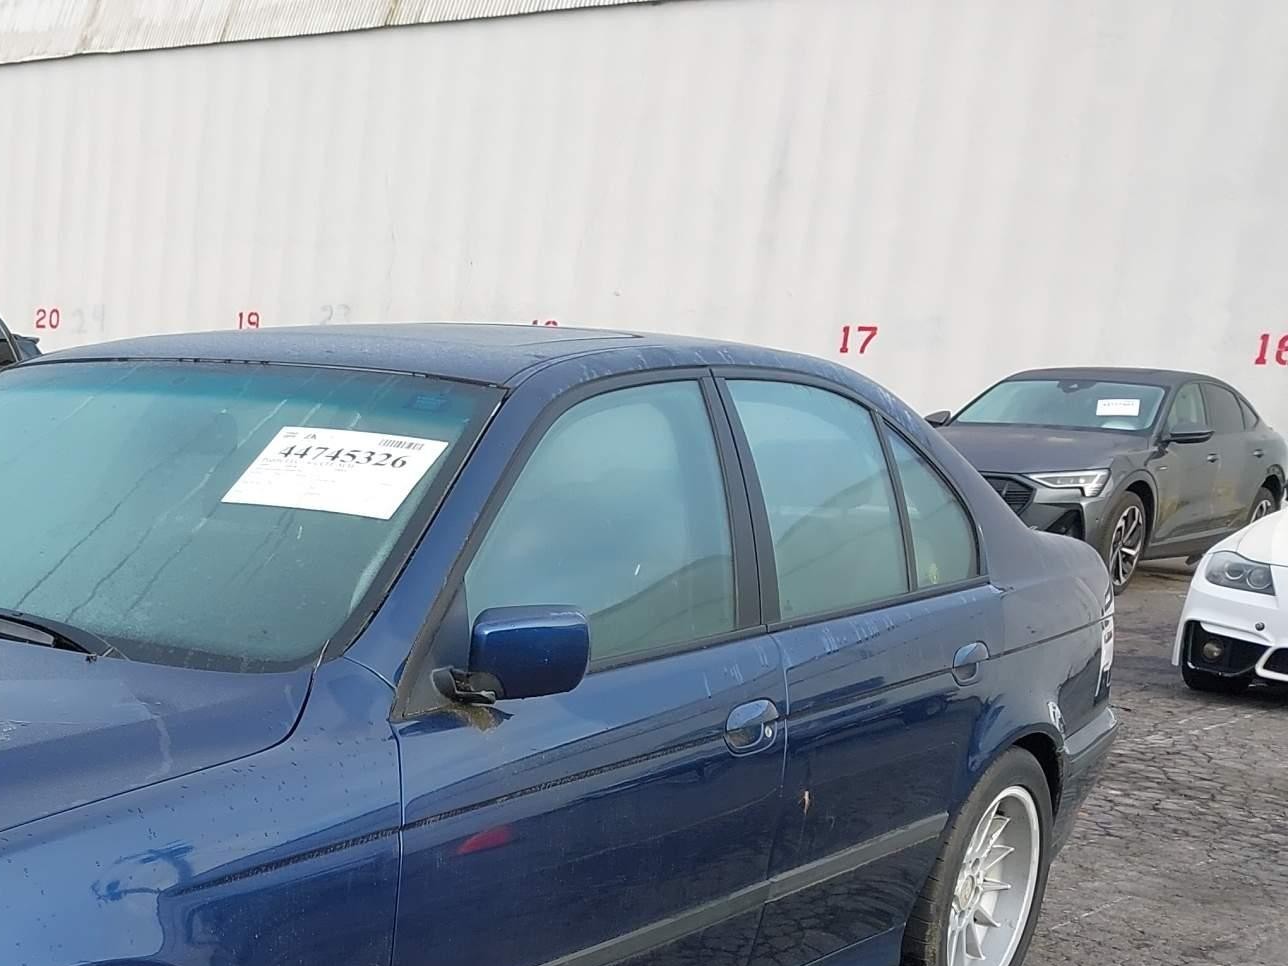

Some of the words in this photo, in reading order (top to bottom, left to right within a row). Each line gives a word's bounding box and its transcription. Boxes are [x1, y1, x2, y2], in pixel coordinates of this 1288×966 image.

[35, 308, 60, 330] 20
[238, 311, 260, 329] 19
[839, 324, 879, 356] 17
[278, 444, 410, 470] 44745326
